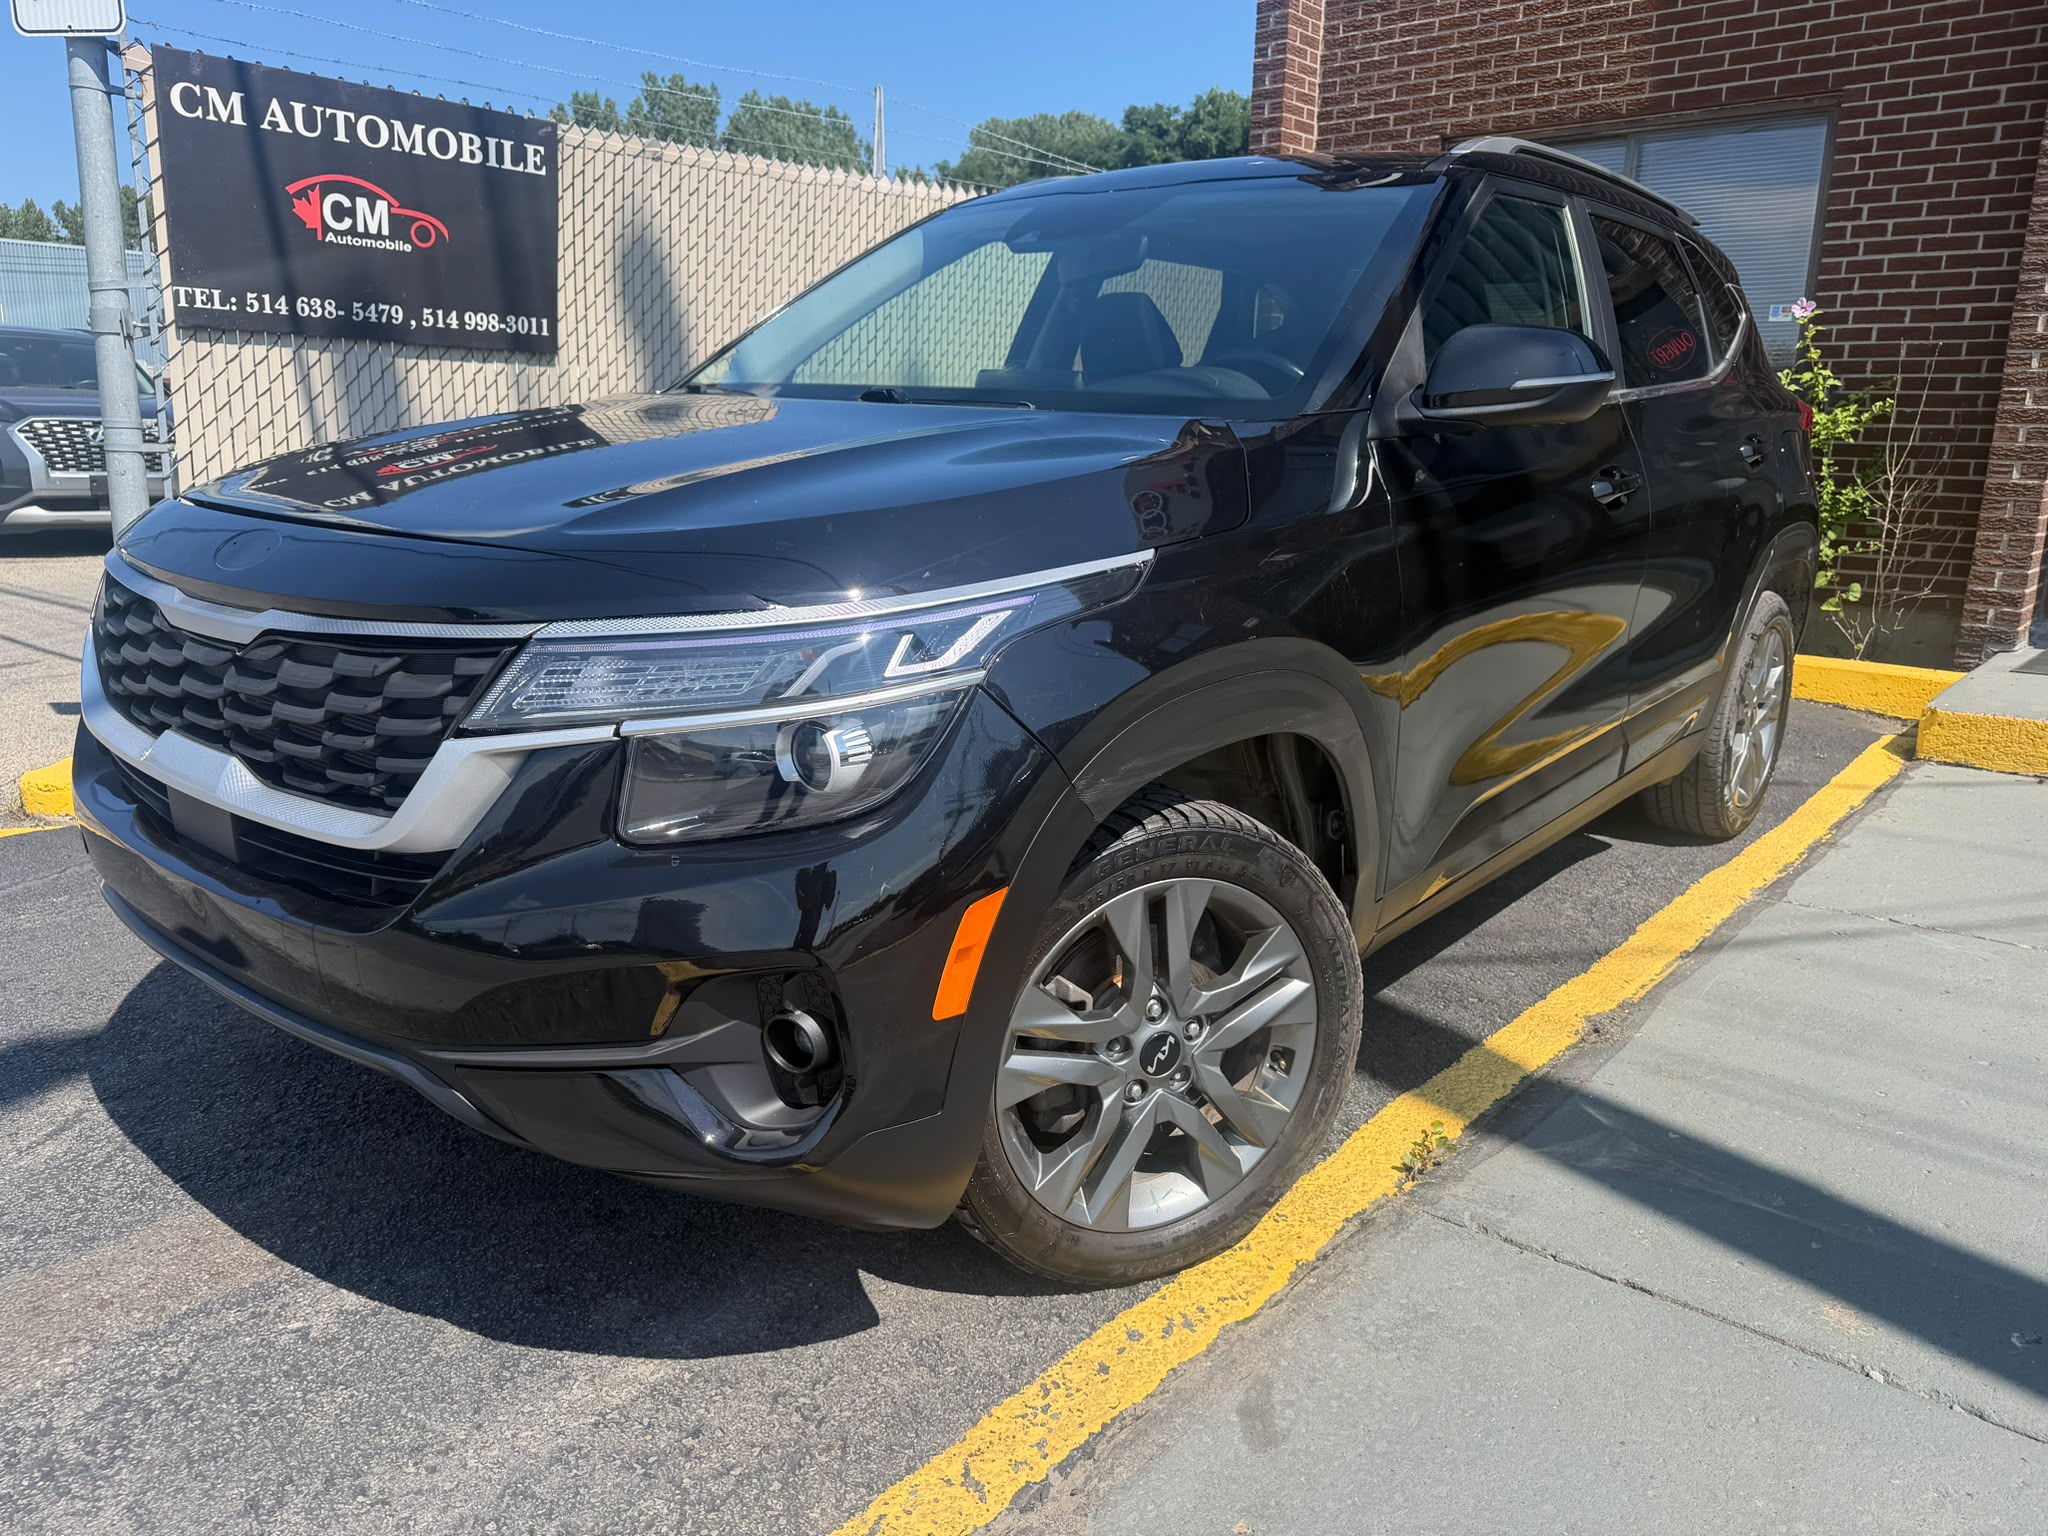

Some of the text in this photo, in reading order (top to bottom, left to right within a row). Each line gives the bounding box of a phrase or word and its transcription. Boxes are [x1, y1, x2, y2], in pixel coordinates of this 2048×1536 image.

[169, 81, 548, 176] CM AUTOMOBILE
[321, 192, 390, 237] CM
[325, 231, 413, 253] Automobile
[172, 286, 238, 312] TEL:
[245, 292, 289, 315] 514
[352, 301, 404, 325] 5479
[421, 307, 460, 330] 514
[464, 311, 551, 337] 998-3011
[1092, 834, 1236, 878] GENERAL
